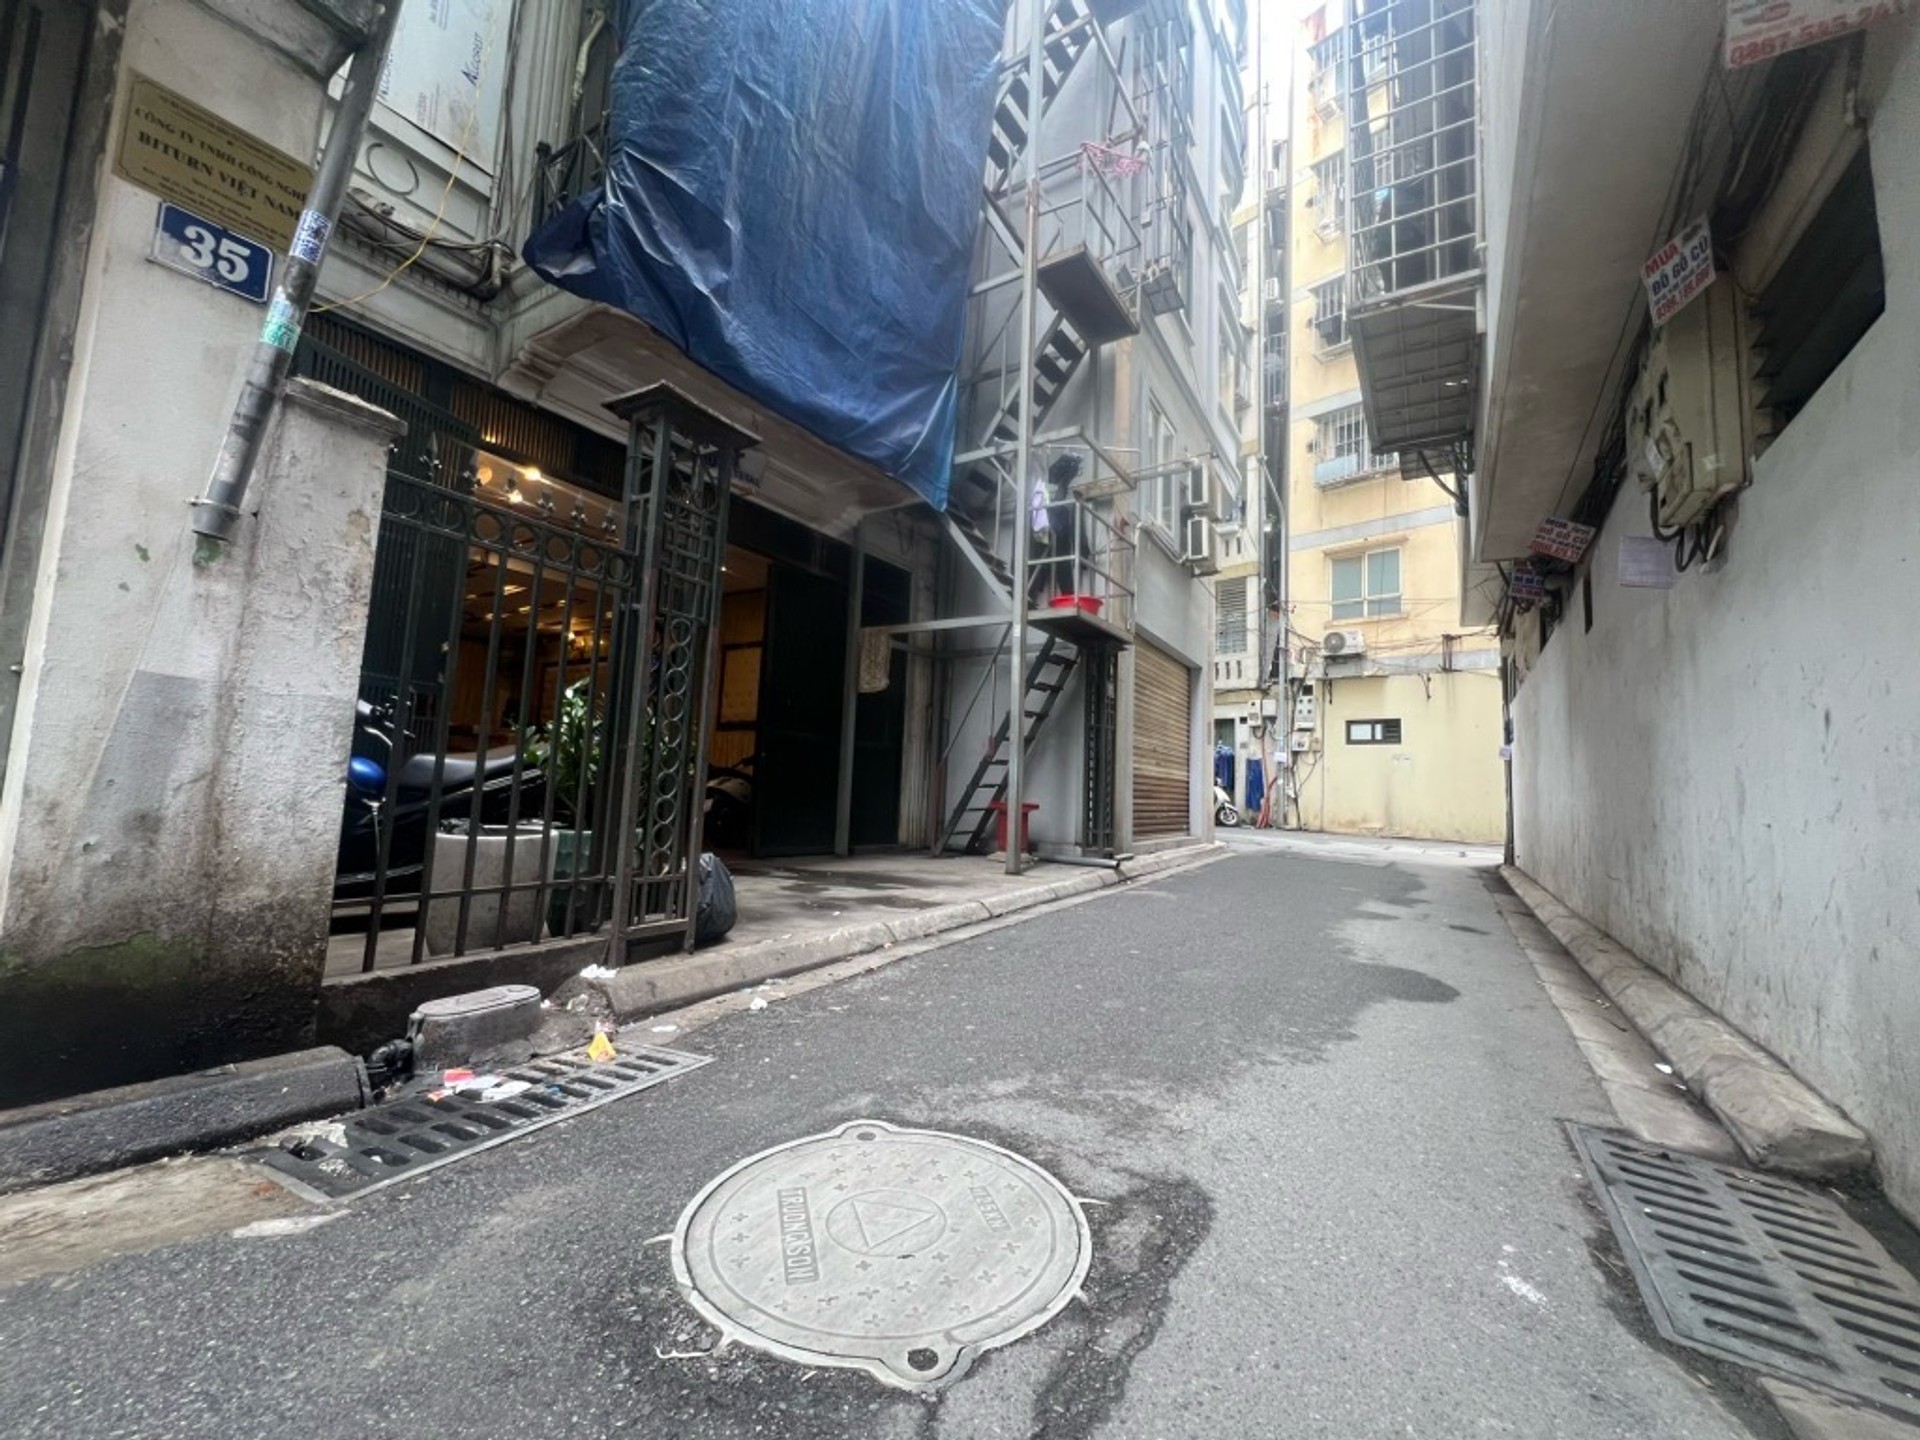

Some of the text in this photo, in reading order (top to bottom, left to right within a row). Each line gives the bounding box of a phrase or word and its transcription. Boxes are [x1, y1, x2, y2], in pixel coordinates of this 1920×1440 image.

[180, 128, 194, 145] TY
[219, 169, 257, 199] VIỆT
[179, 224, 250, 284] 35
[1644, 241, 1680, 279] MUA
